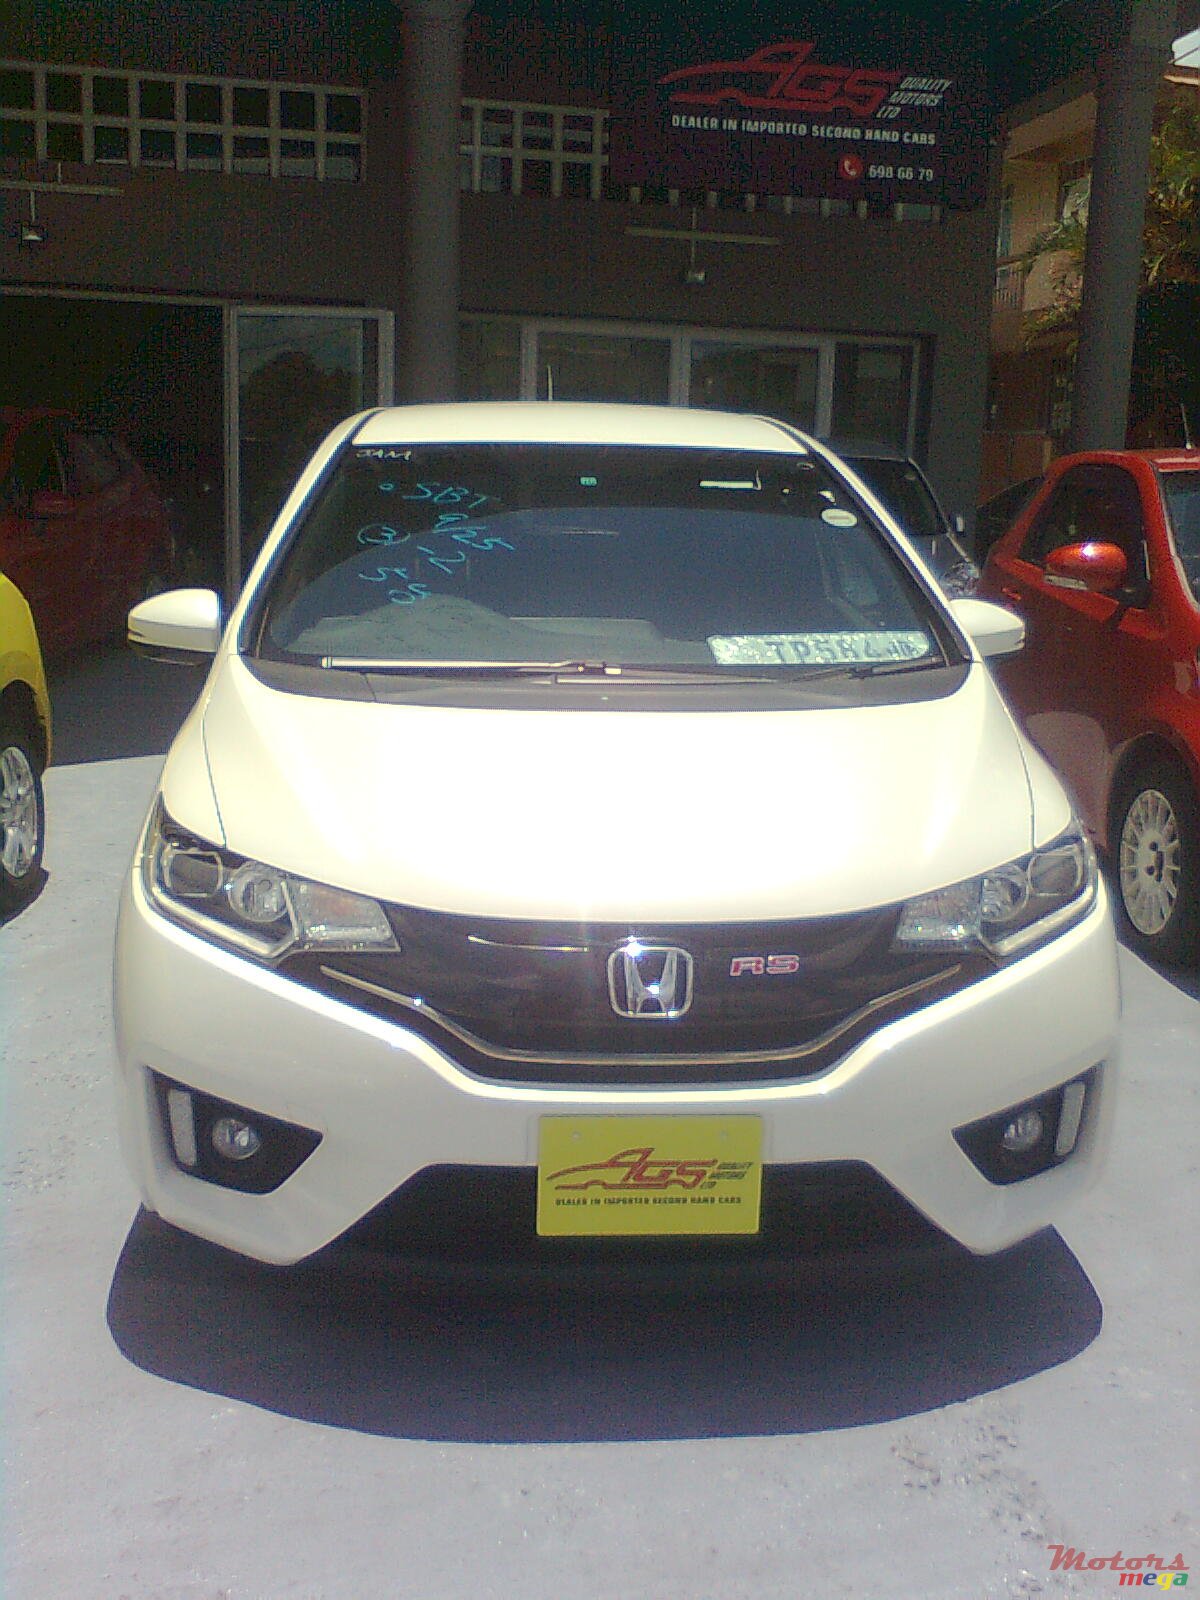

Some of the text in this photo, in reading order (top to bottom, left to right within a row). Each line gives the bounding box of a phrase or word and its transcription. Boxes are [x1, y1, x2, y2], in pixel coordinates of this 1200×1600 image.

[671, 114, 936, 145] DEALER IN IMPORTED SECOND HAND CARS
[917, 165, 934, 182] 79
[730, 954, 800, 977] RS
